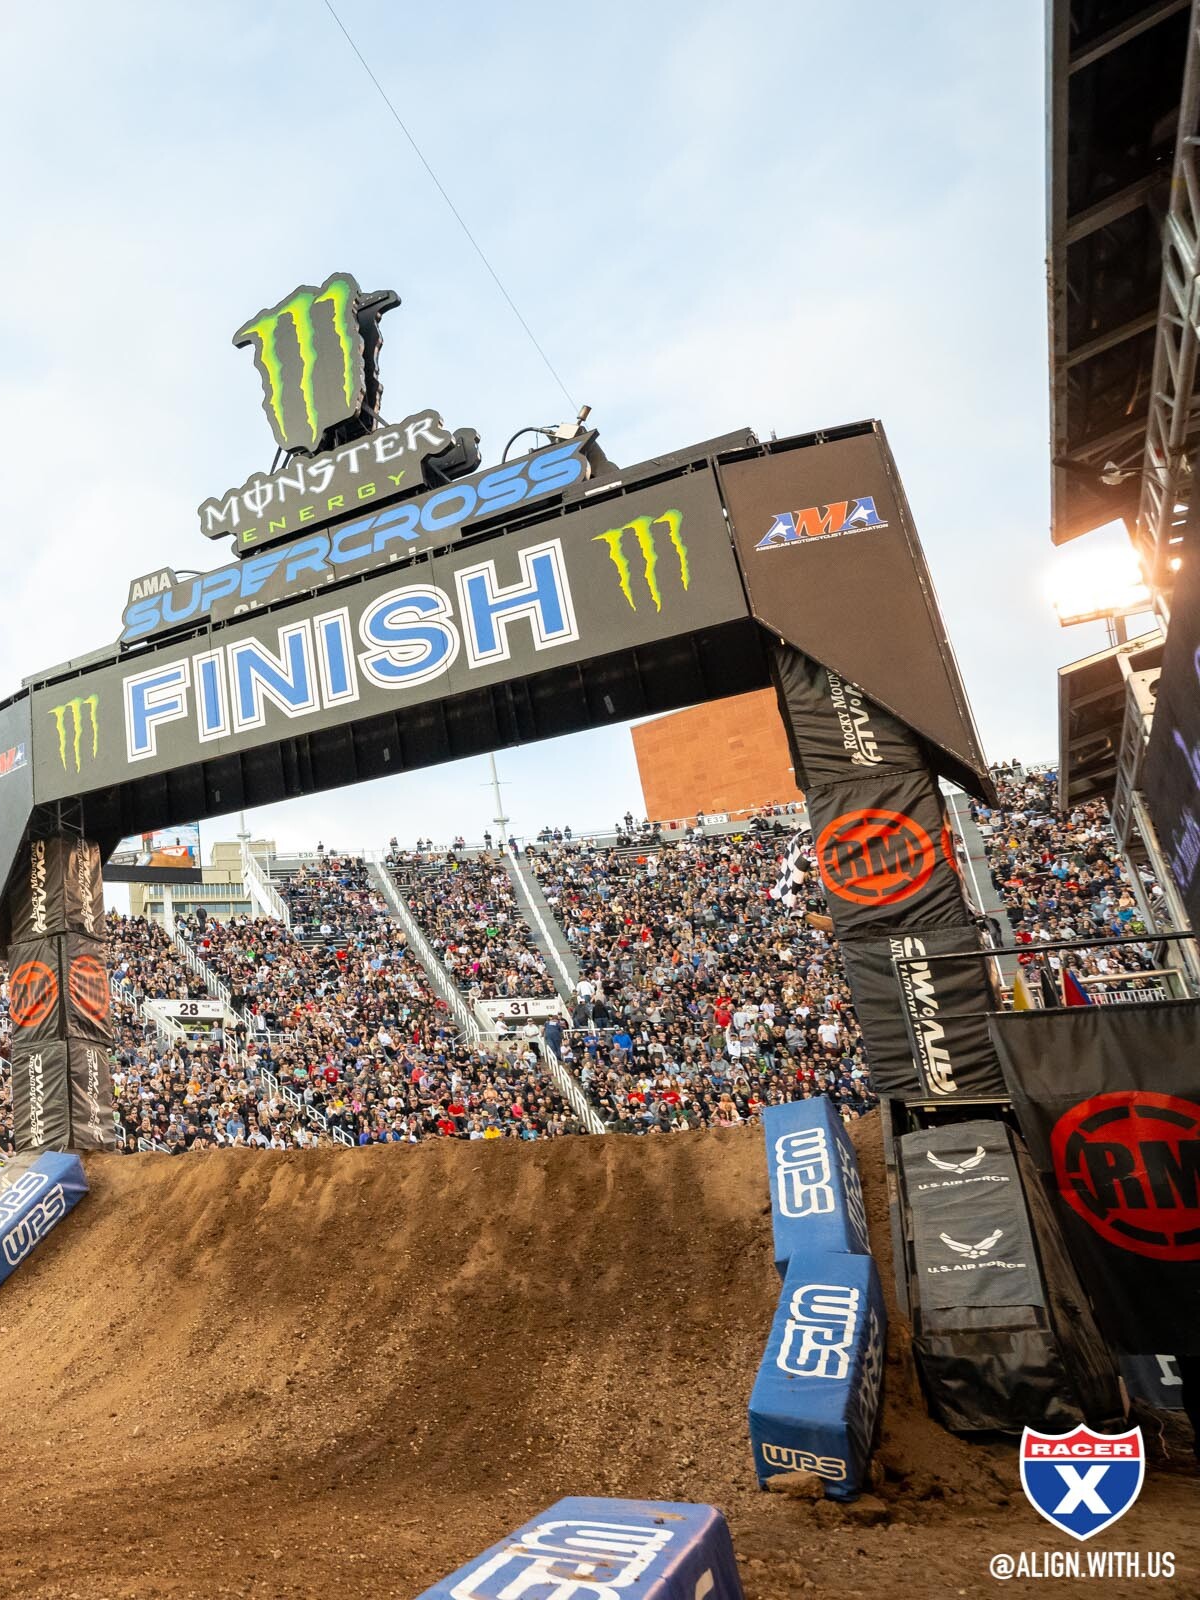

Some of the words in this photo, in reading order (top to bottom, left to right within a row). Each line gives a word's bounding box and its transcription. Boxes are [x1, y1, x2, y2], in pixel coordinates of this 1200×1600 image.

[205, 417, 445, 531] MONSTER
[241, 470, 405, 544] ENERGY
[753, 496, 888, 547] AMA
[125, 441, 584, 642] SUPERCROSS
[755, 541, 790, 552] AMERICAN
[791, 532, 842, 545] MOTORCYCLIST
[843, 524, 889, 536] ASSOCIATION
[132, 572, 172, 602] AMA
[123, 538, 580, 763] FINISH
[826, 669, 848, 709] MOUN
[837, 711, 858, 750] ROCKY
[180, 1003, 199, 1016] 28
[510, 1002, 529, 1015] 31
[775, 1127, 835, 1218] WPS
[2, 1183, 66, 1266] WPS
[978, 1261, 1026, 1269] FORCE
[777, 1284, 860, 1380] WPS
[762, 1443, 847, 1481] WPS
